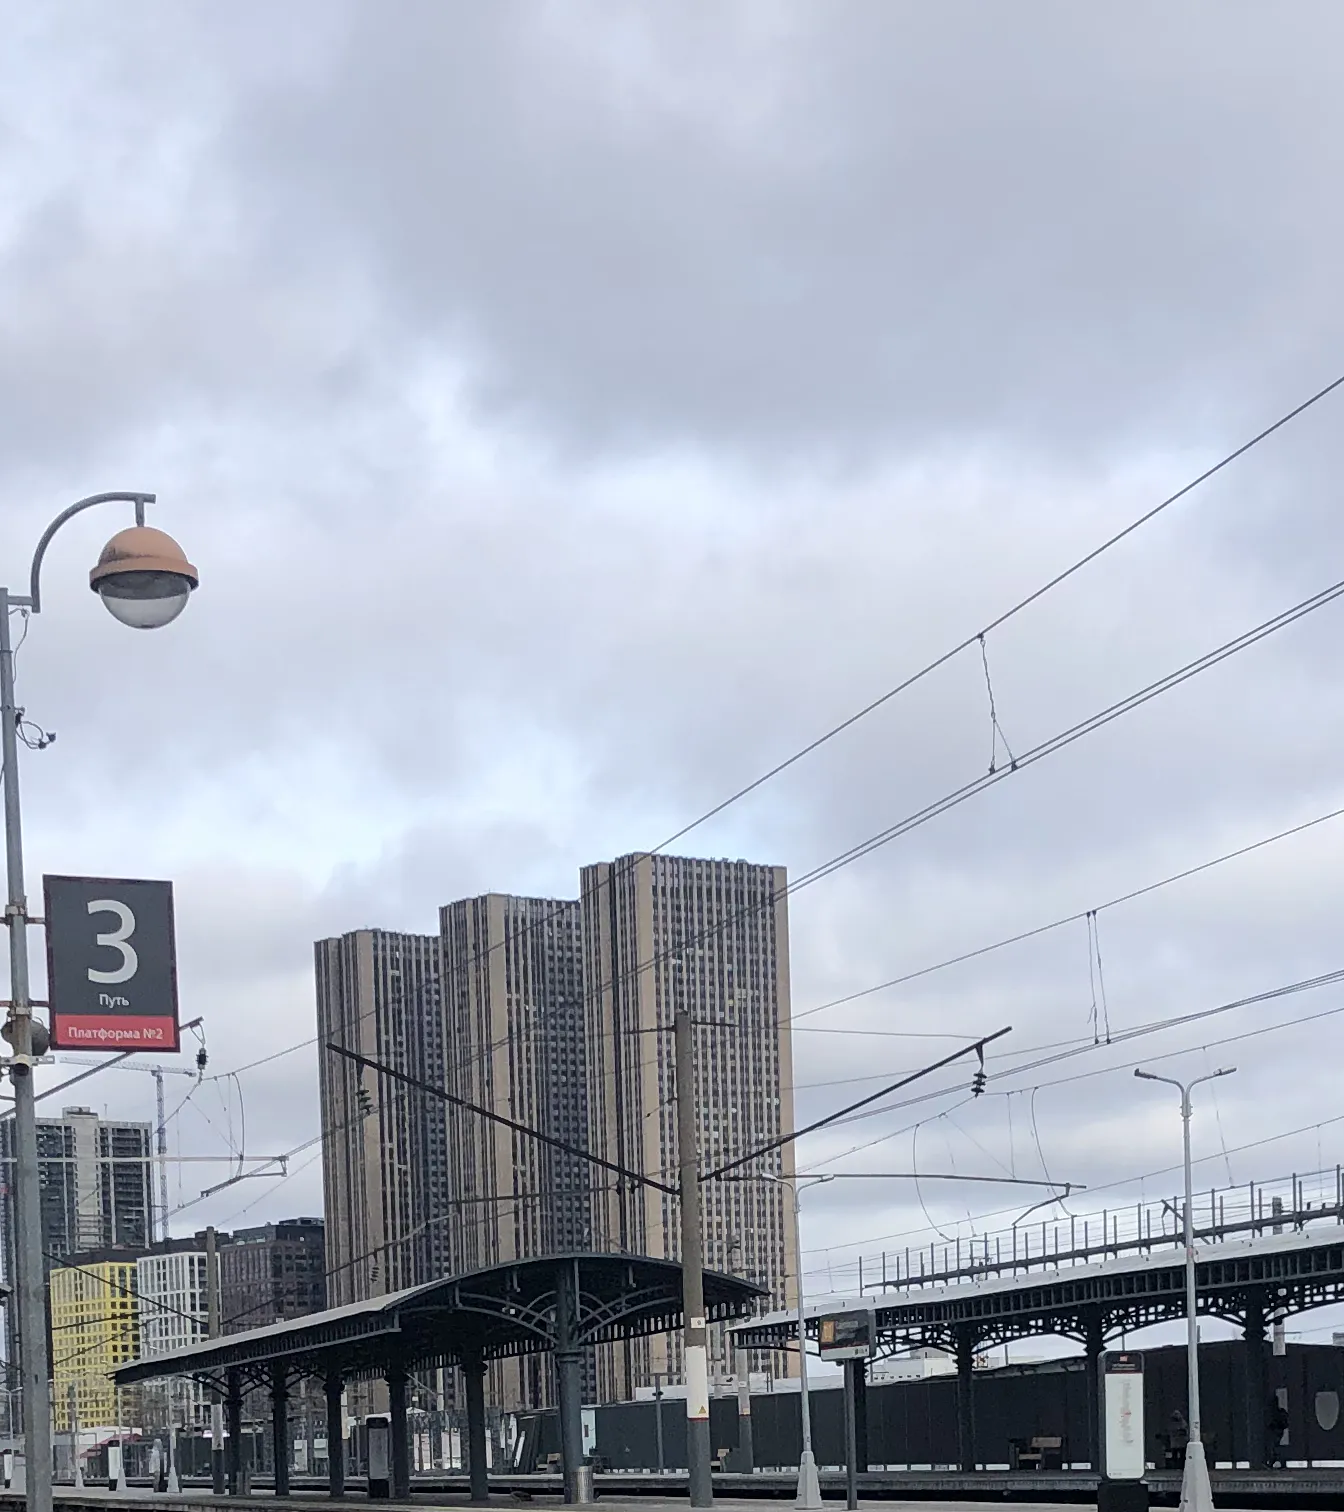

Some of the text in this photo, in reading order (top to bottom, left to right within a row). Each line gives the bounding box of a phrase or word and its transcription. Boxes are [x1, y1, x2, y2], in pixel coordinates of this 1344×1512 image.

[87, 900, 139, 984] 3
[99, 993, 131, 1008] Путь
[68, 1026, 163, 1042] Платформа №2
